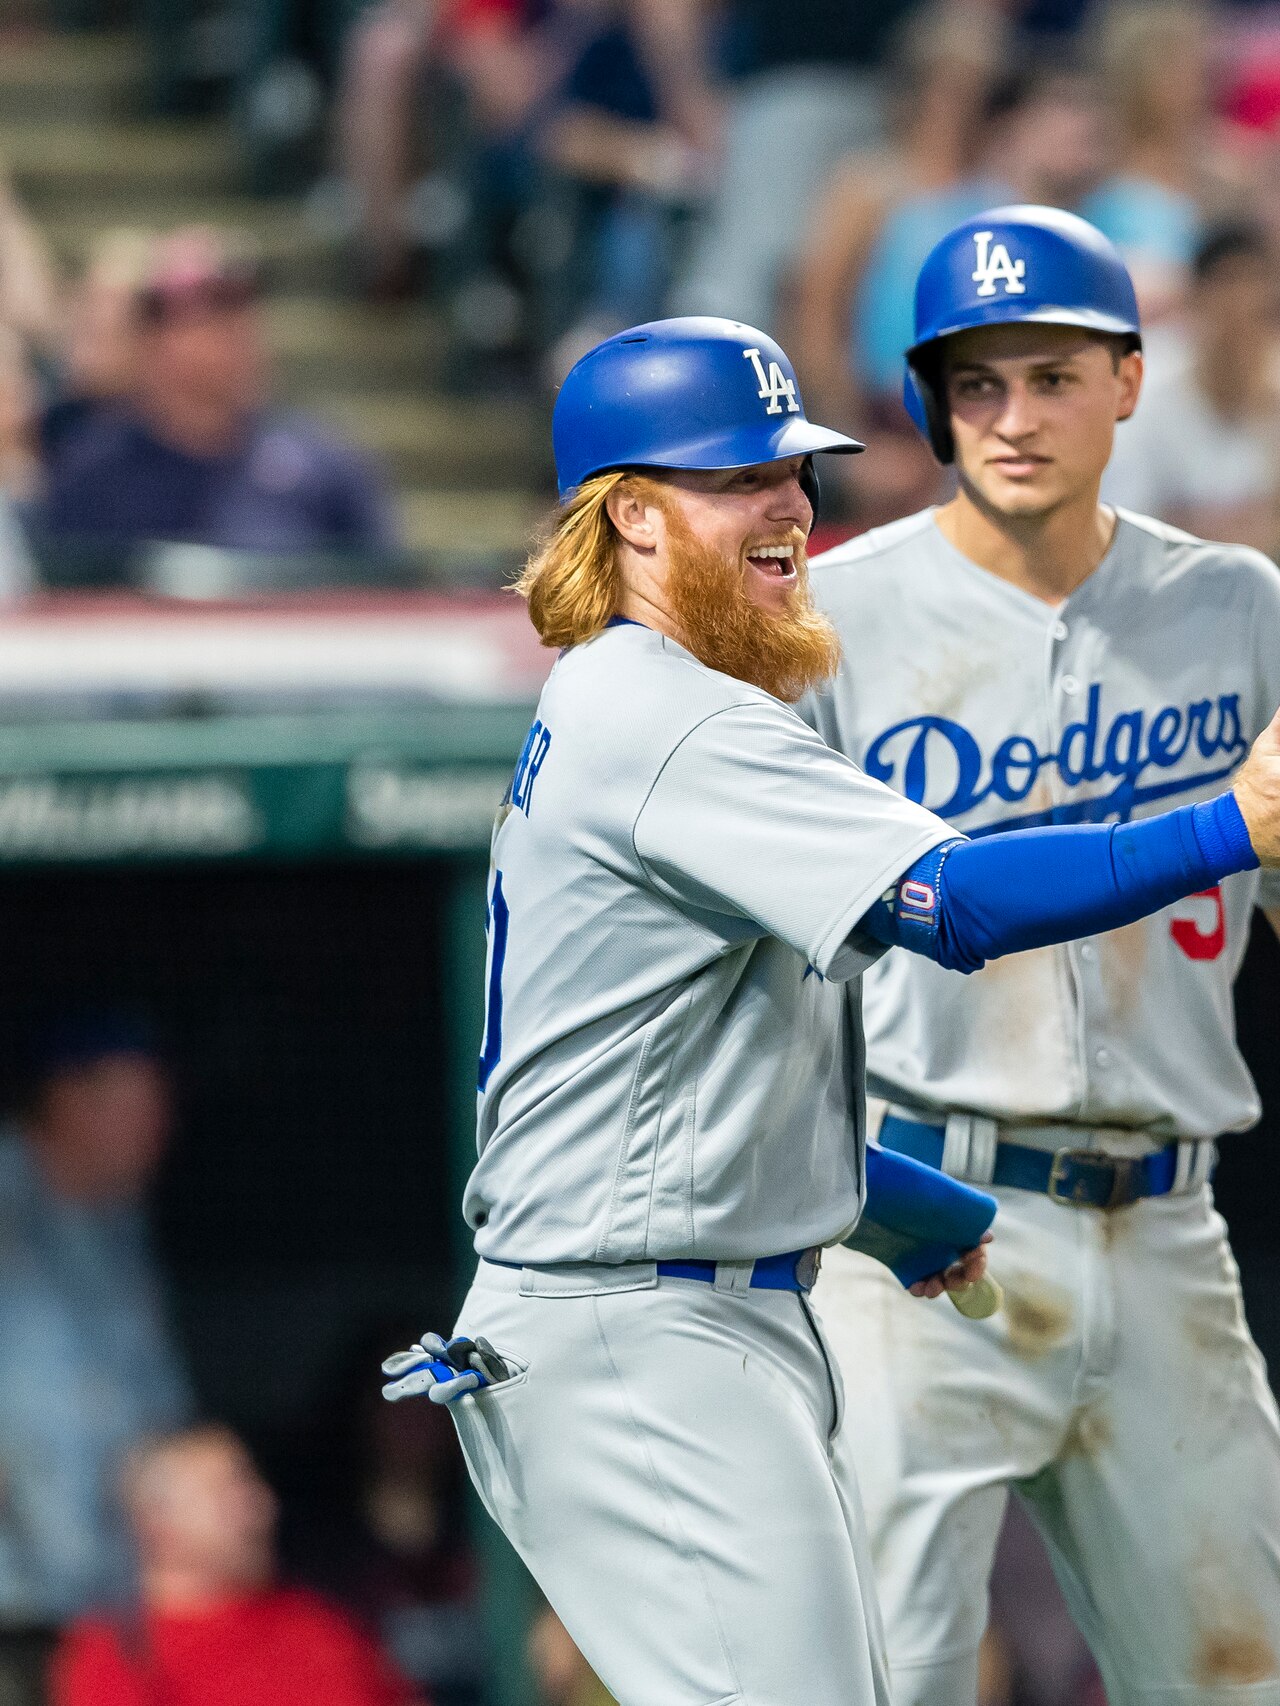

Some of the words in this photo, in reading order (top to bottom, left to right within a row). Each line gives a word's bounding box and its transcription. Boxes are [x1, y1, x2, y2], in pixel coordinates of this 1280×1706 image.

[972, 231, 1026, 297] LA
[743, 348, 800, 415] LA
[865, 683, 1247, 826] Dodgers
[899, 880, 935, 926] 10
